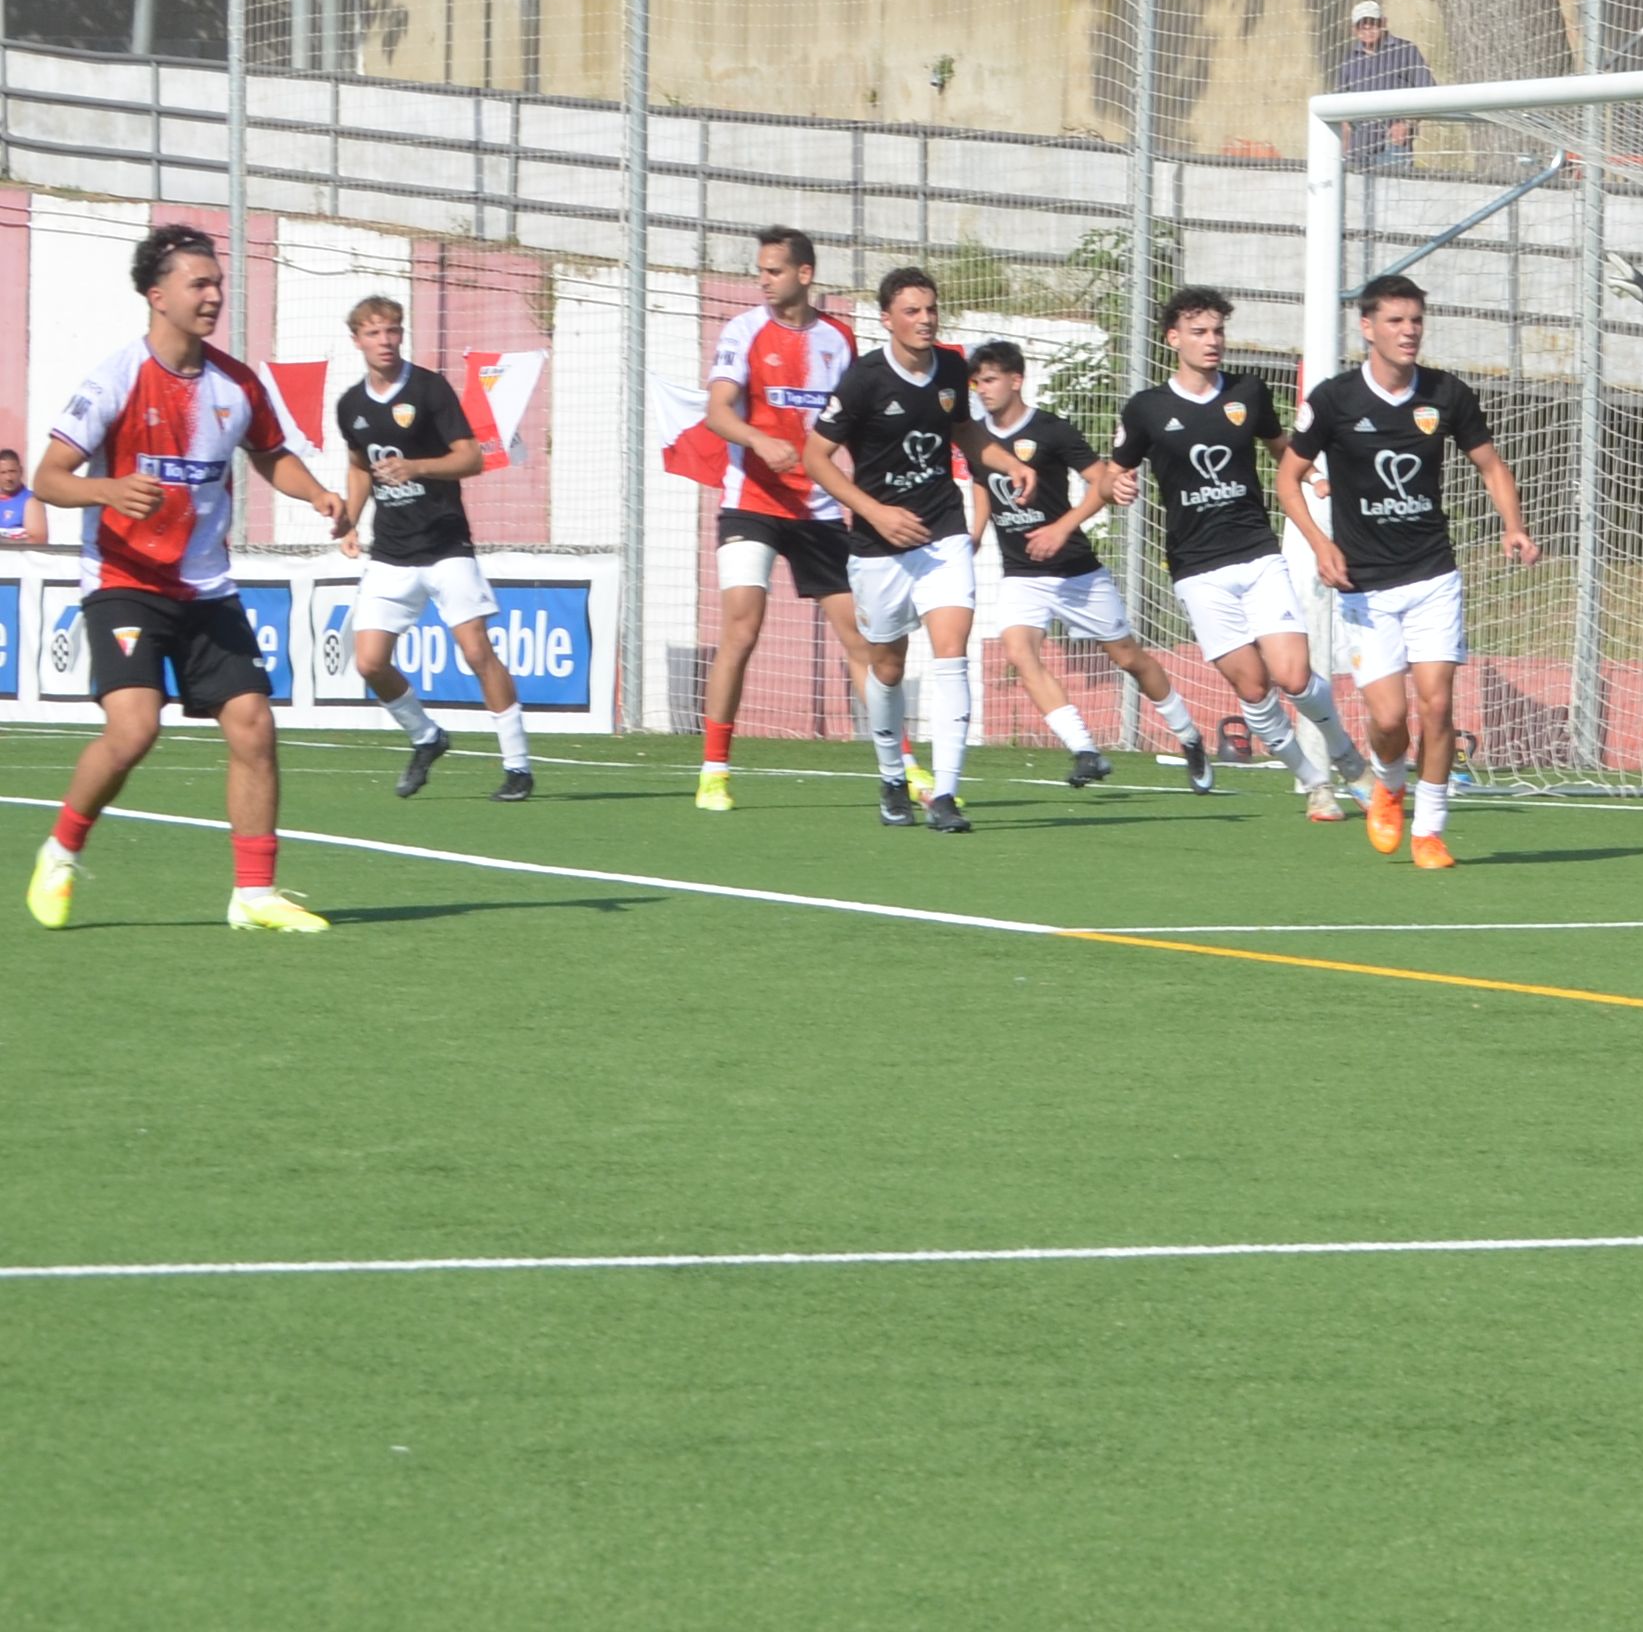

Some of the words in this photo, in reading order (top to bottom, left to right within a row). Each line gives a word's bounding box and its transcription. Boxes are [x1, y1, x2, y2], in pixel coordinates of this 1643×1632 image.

[1181, 480, 1247, 506] LaPobla
[1360, 494, 1433, 516] LaPobla
[393, 624, 447, 692] op
